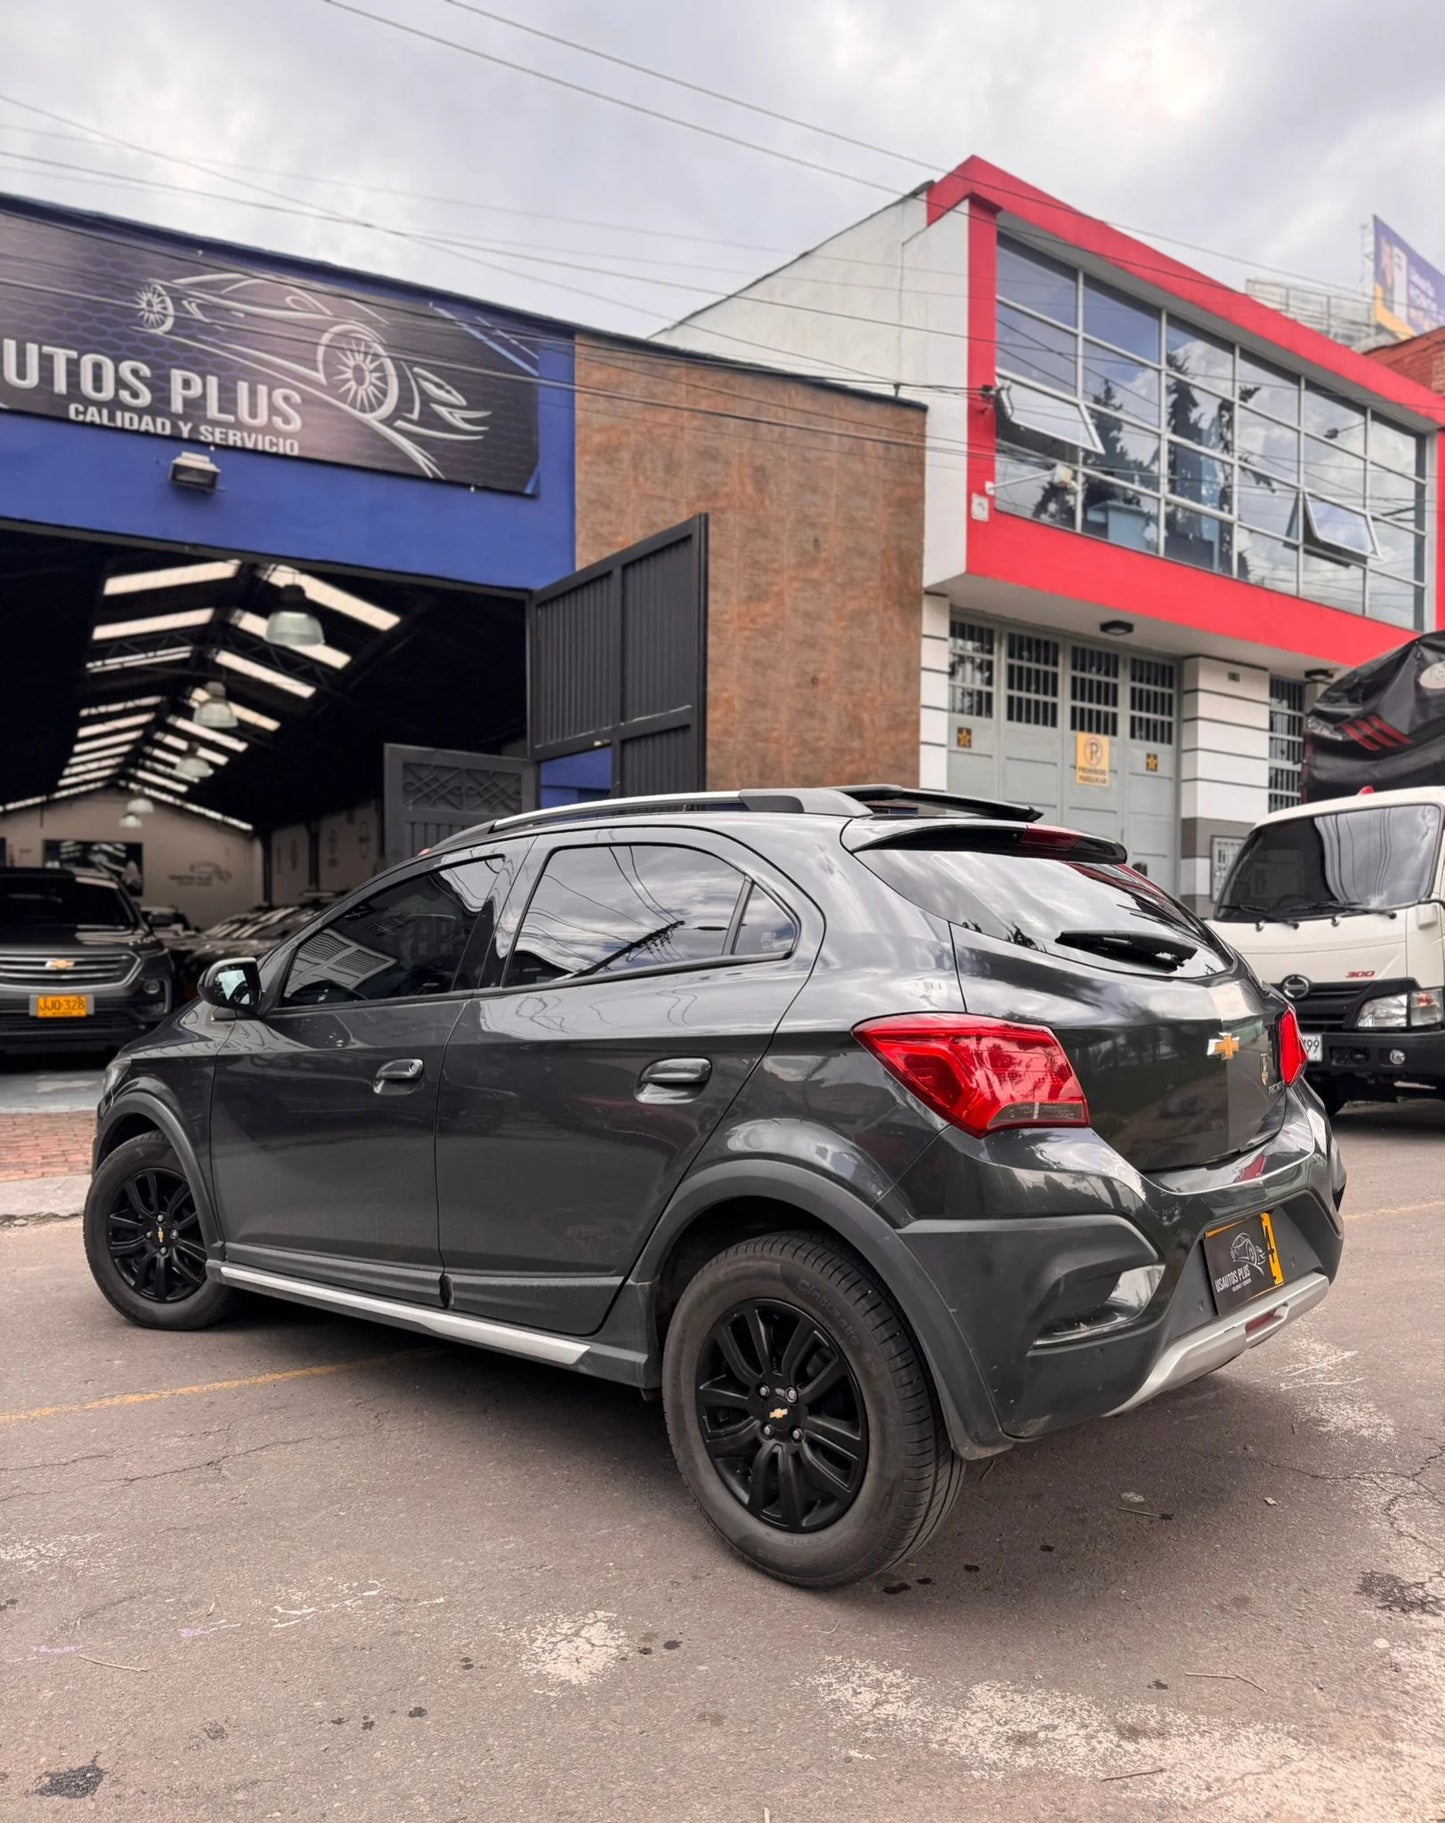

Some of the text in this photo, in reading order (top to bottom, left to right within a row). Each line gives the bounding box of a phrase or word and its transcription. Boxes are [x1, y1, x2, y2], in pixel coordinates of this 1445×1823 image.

[2, 338, 302, 433] UTOS PLUS
[68, 403, 299, 456] CALIDAD Y SERVICIO
[1345, 970, 1375, 978] 300
